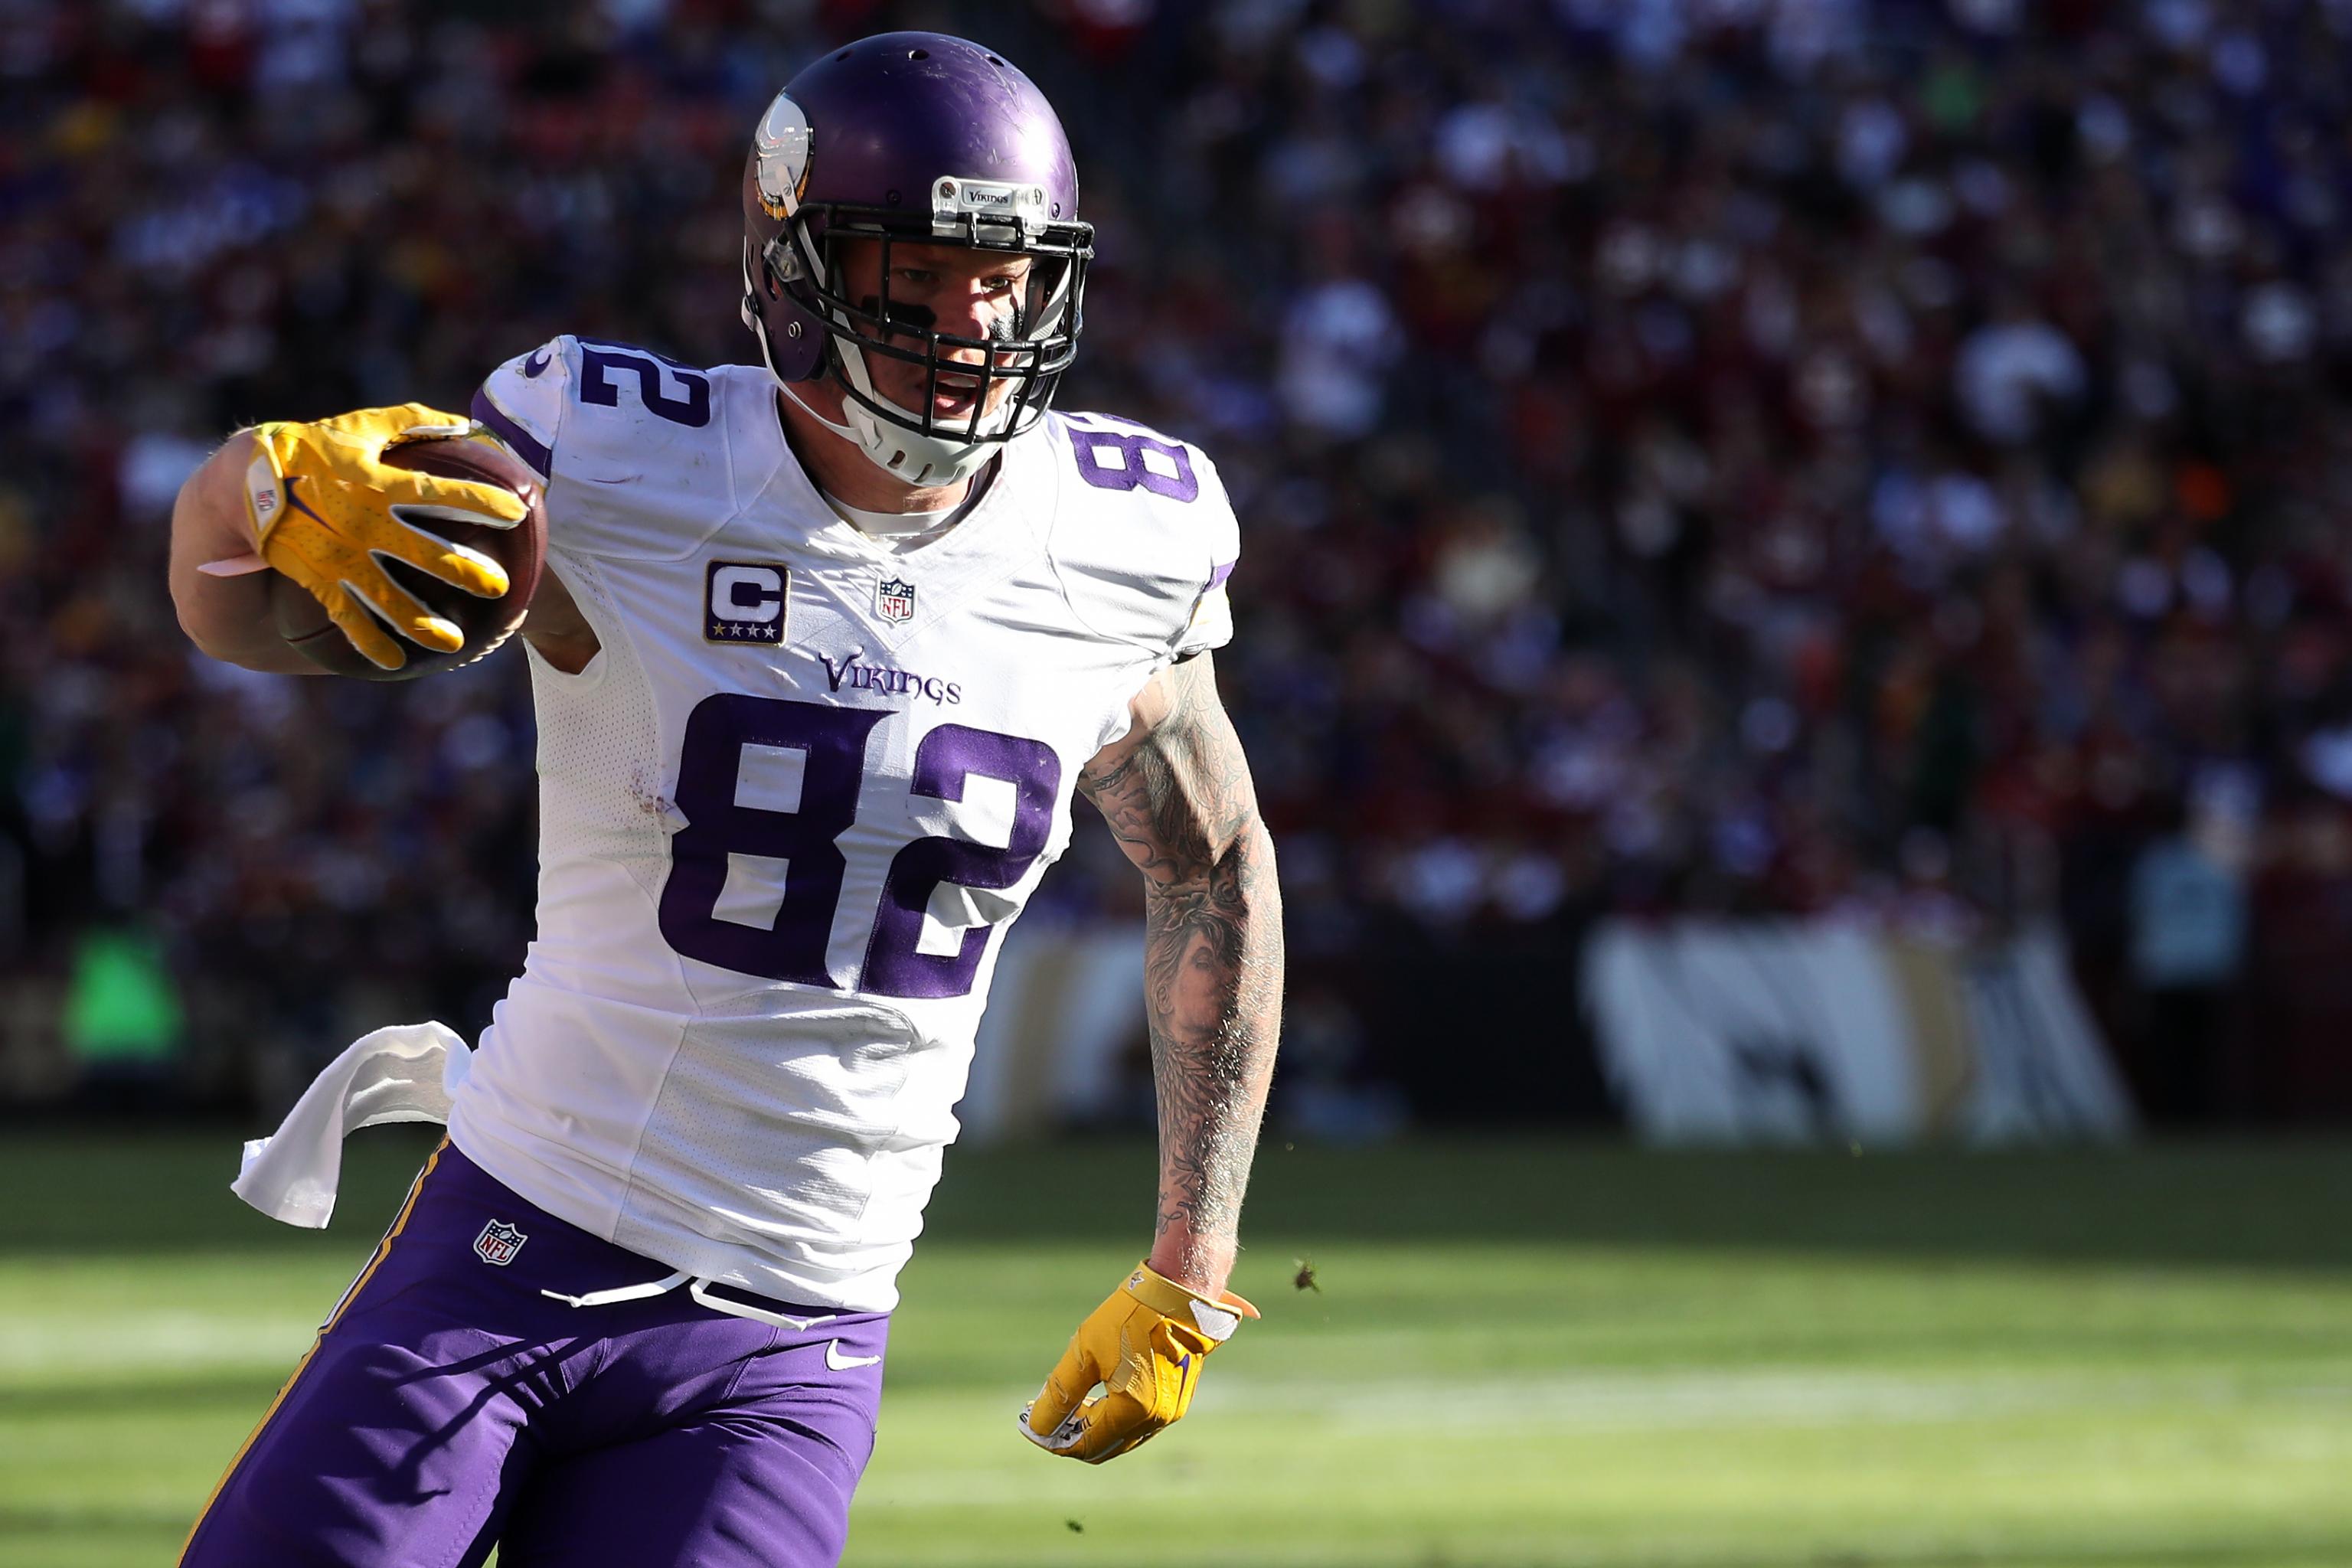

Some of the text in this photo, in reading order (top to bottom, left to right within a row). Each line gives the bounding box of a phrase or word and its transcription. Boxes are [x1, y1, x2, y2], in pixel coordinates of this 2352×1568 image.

[712, 566, 782, 622] C
[881, 597, 910, 618] NFL
[658, 692, 1062, 1000] 82
[480, 1235, 510, 1260] NFL
